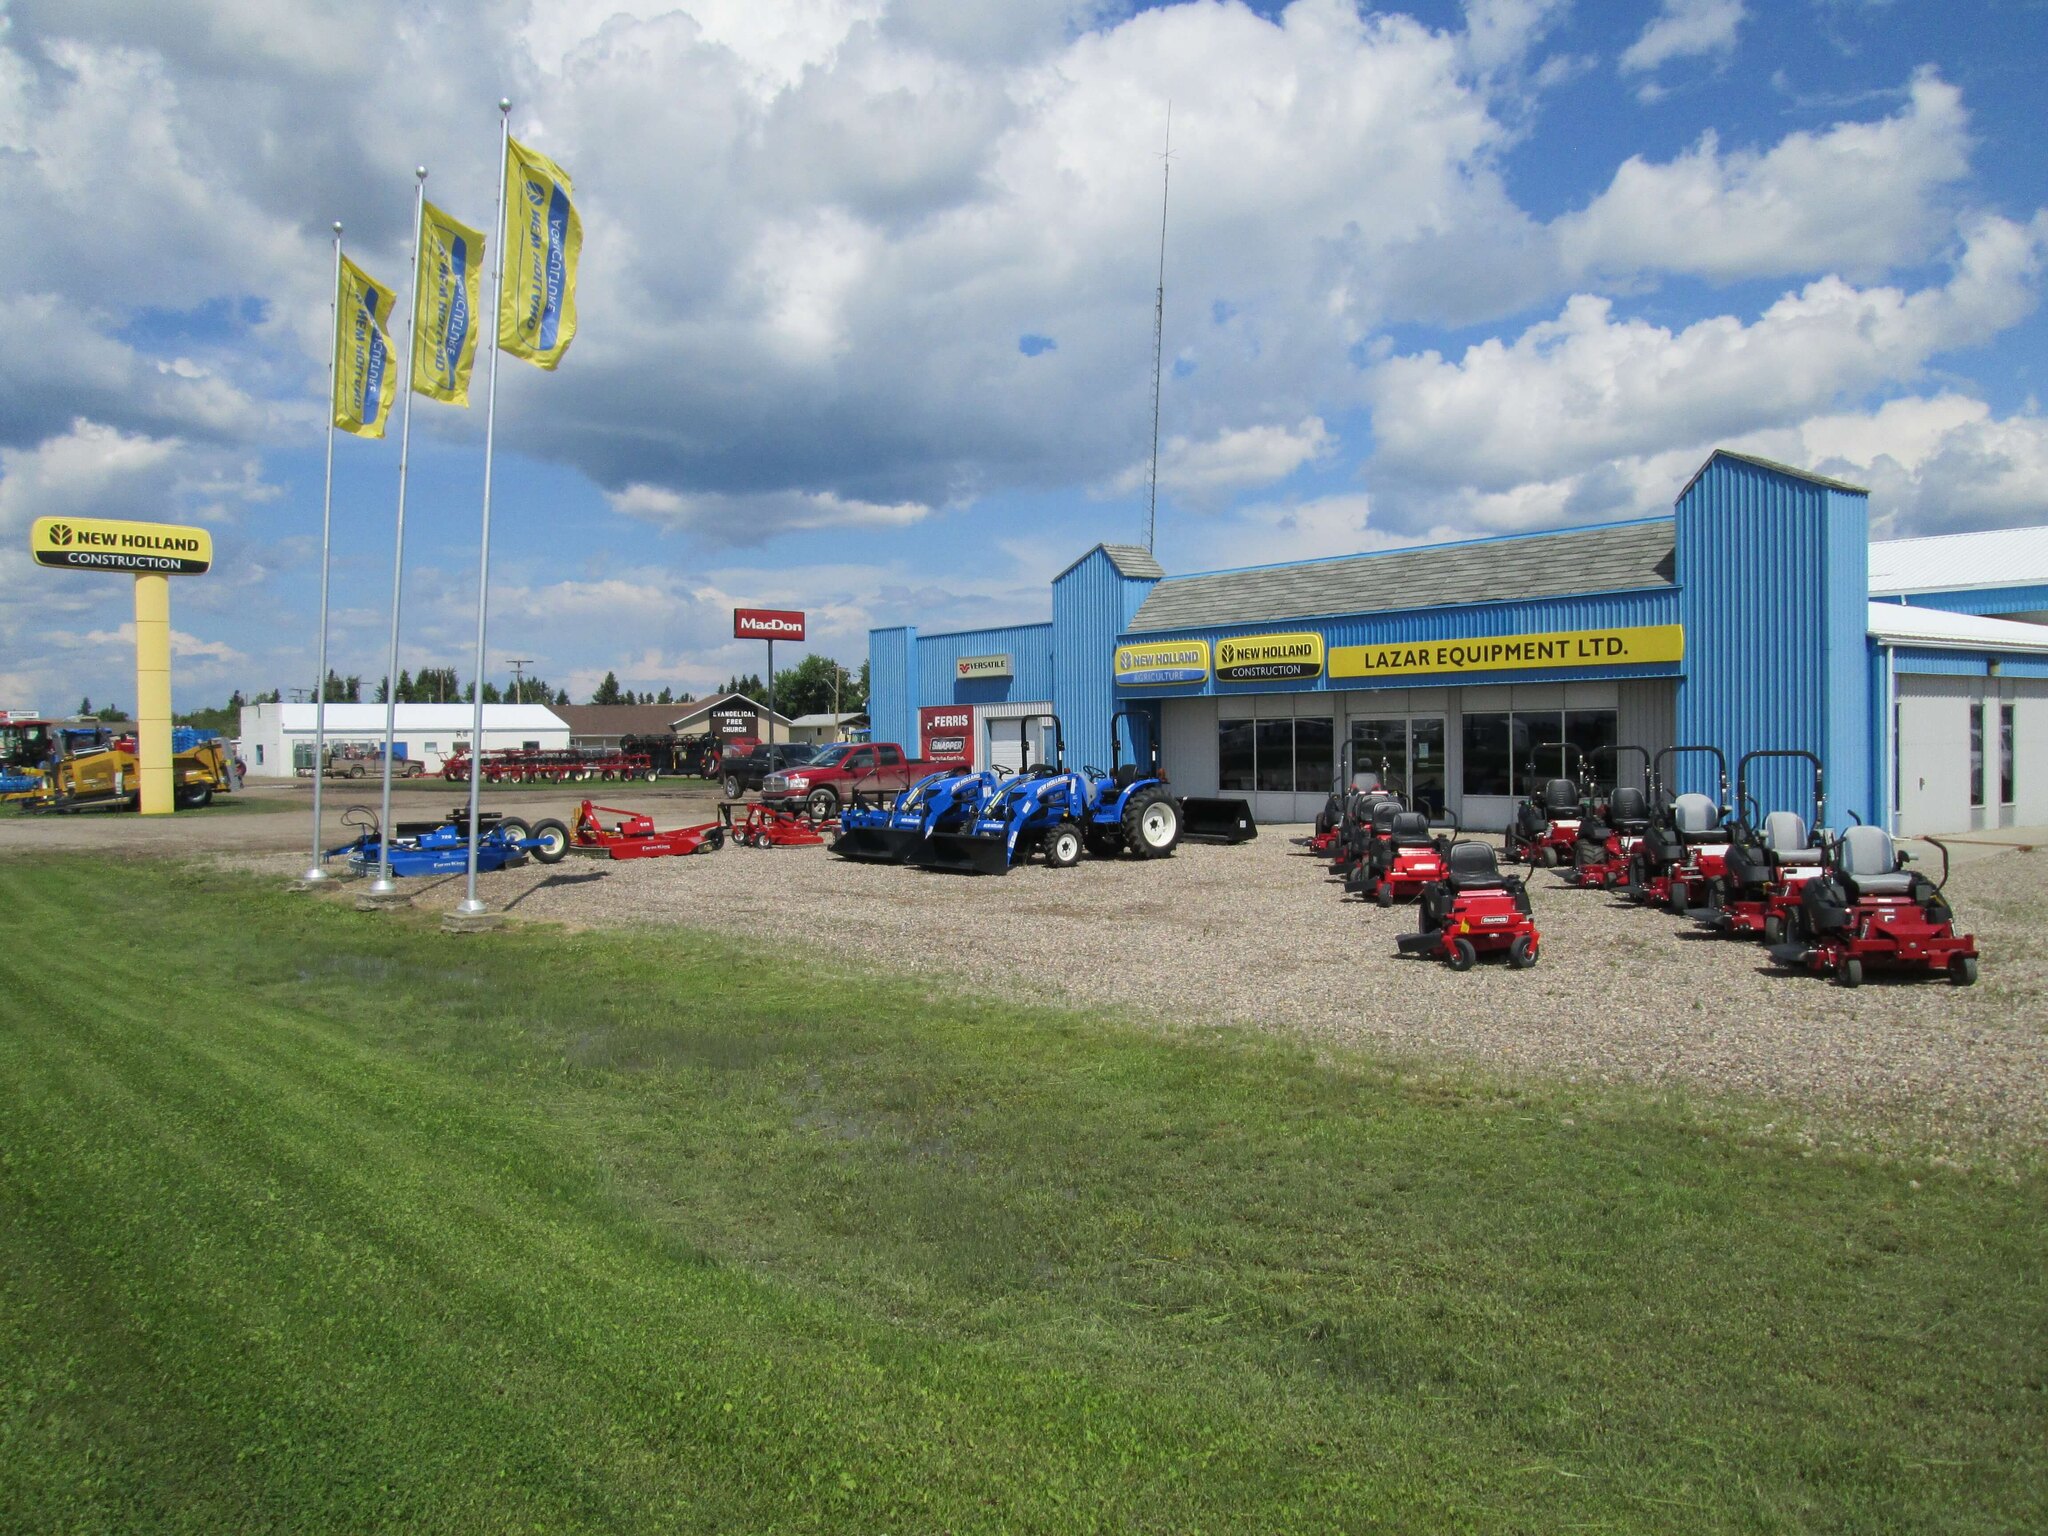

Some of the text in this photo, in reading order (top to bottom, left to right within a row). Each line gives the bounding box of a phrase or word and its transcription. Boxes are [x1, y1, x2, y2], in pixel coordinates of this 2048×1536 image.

[77, 531, 199, 552] NEW HOLLAND
[67, 552, 181, 569] CONSTRUCTION
[741, 617, 802, 631] MacDon
[1237, 644, 1312, 660] NEW HOLLAND
[1365, 637, 1628, 668] LAZAR EQUIPMENT LTD.
[970, 660, 1005, 670] VERSATILE
[1133, 651, 1199, 667] NEW HOLLAND
[1134, 671, 1183, 681] AGRICULTURE
[1231, 665, 1301, 677] CONSTRUCTION
[712, 710, 756, 718] EVANGELICAL
[934, 714, 969, 727] FERRIS
[931, 740, 963, 750] SNAPPER
